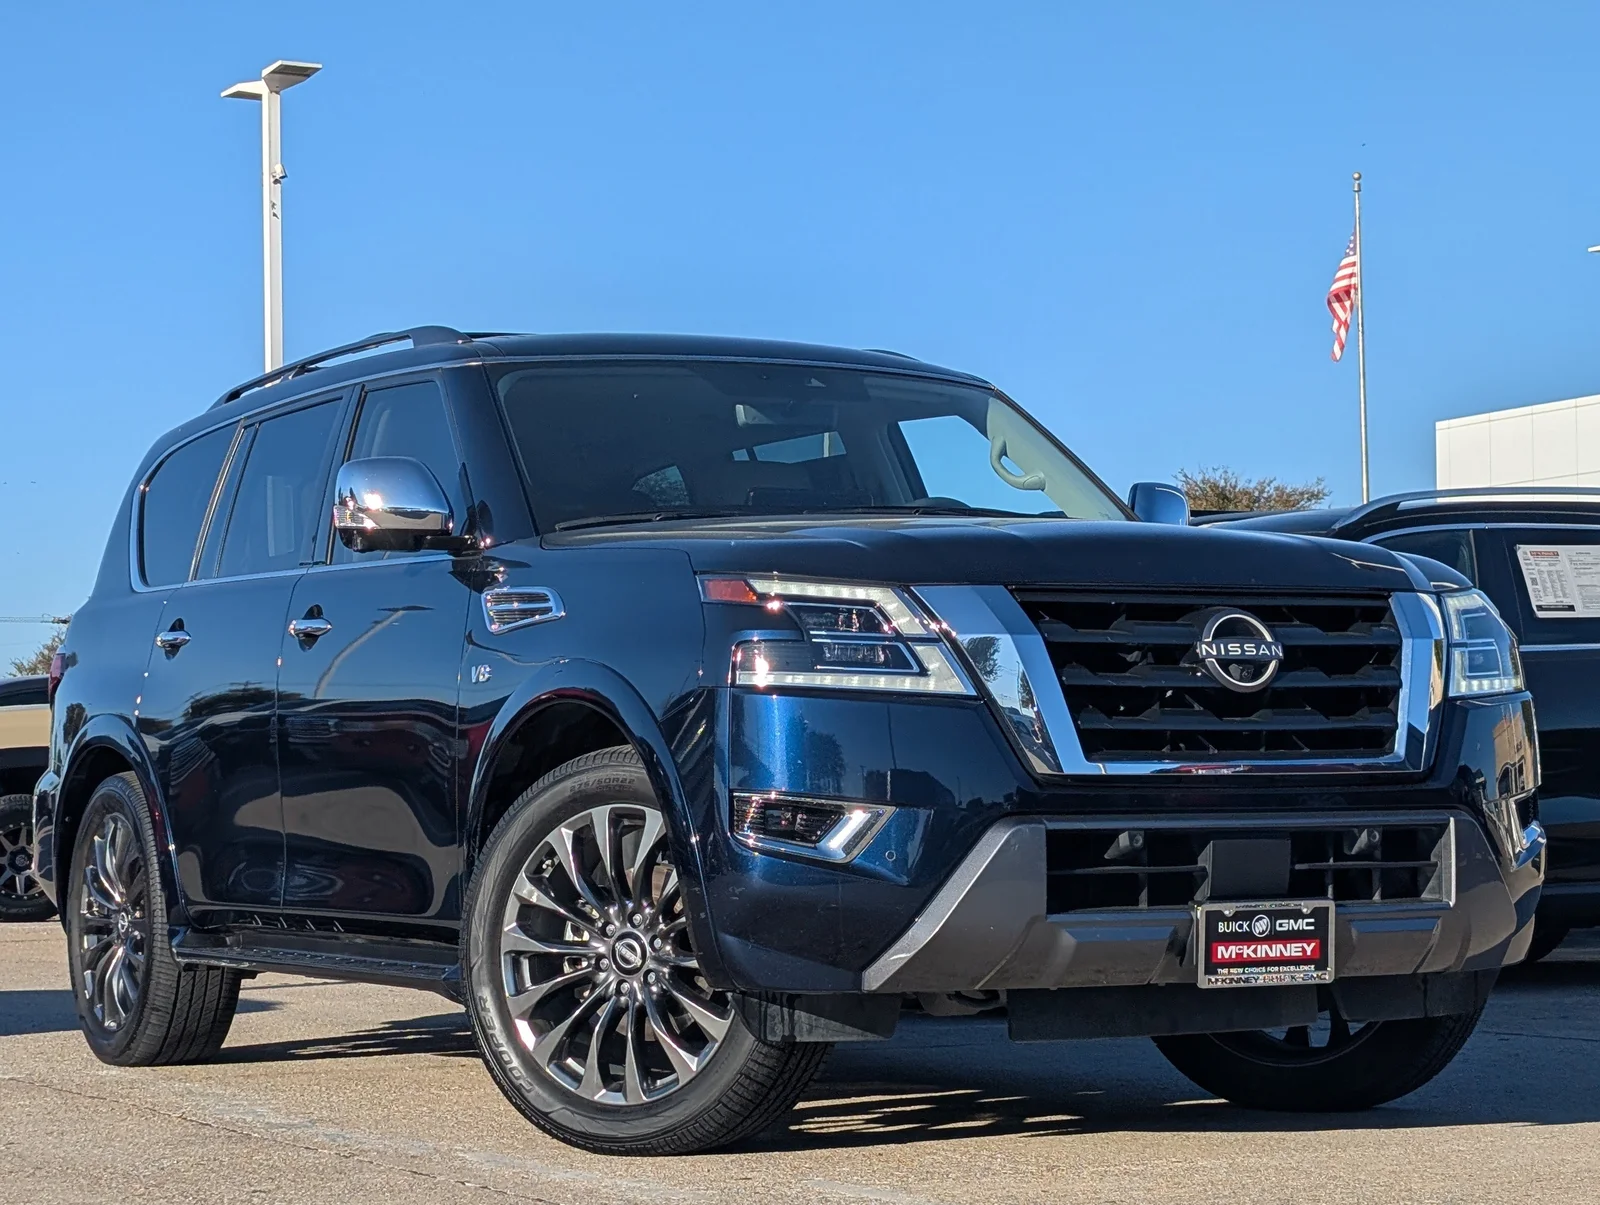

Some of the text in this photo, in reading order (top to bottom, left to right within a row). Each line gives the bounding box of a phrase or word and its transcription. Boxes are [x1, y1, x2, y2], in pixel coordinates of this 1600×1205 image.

[1201, 643, 1283, 657] NISSAN
[1218, 918, 1315, 933] BUICK GMC
[1217, 942, 1316, 959] McKINNEY
[1280, 964, 1316, 972] EXCELLENCE
